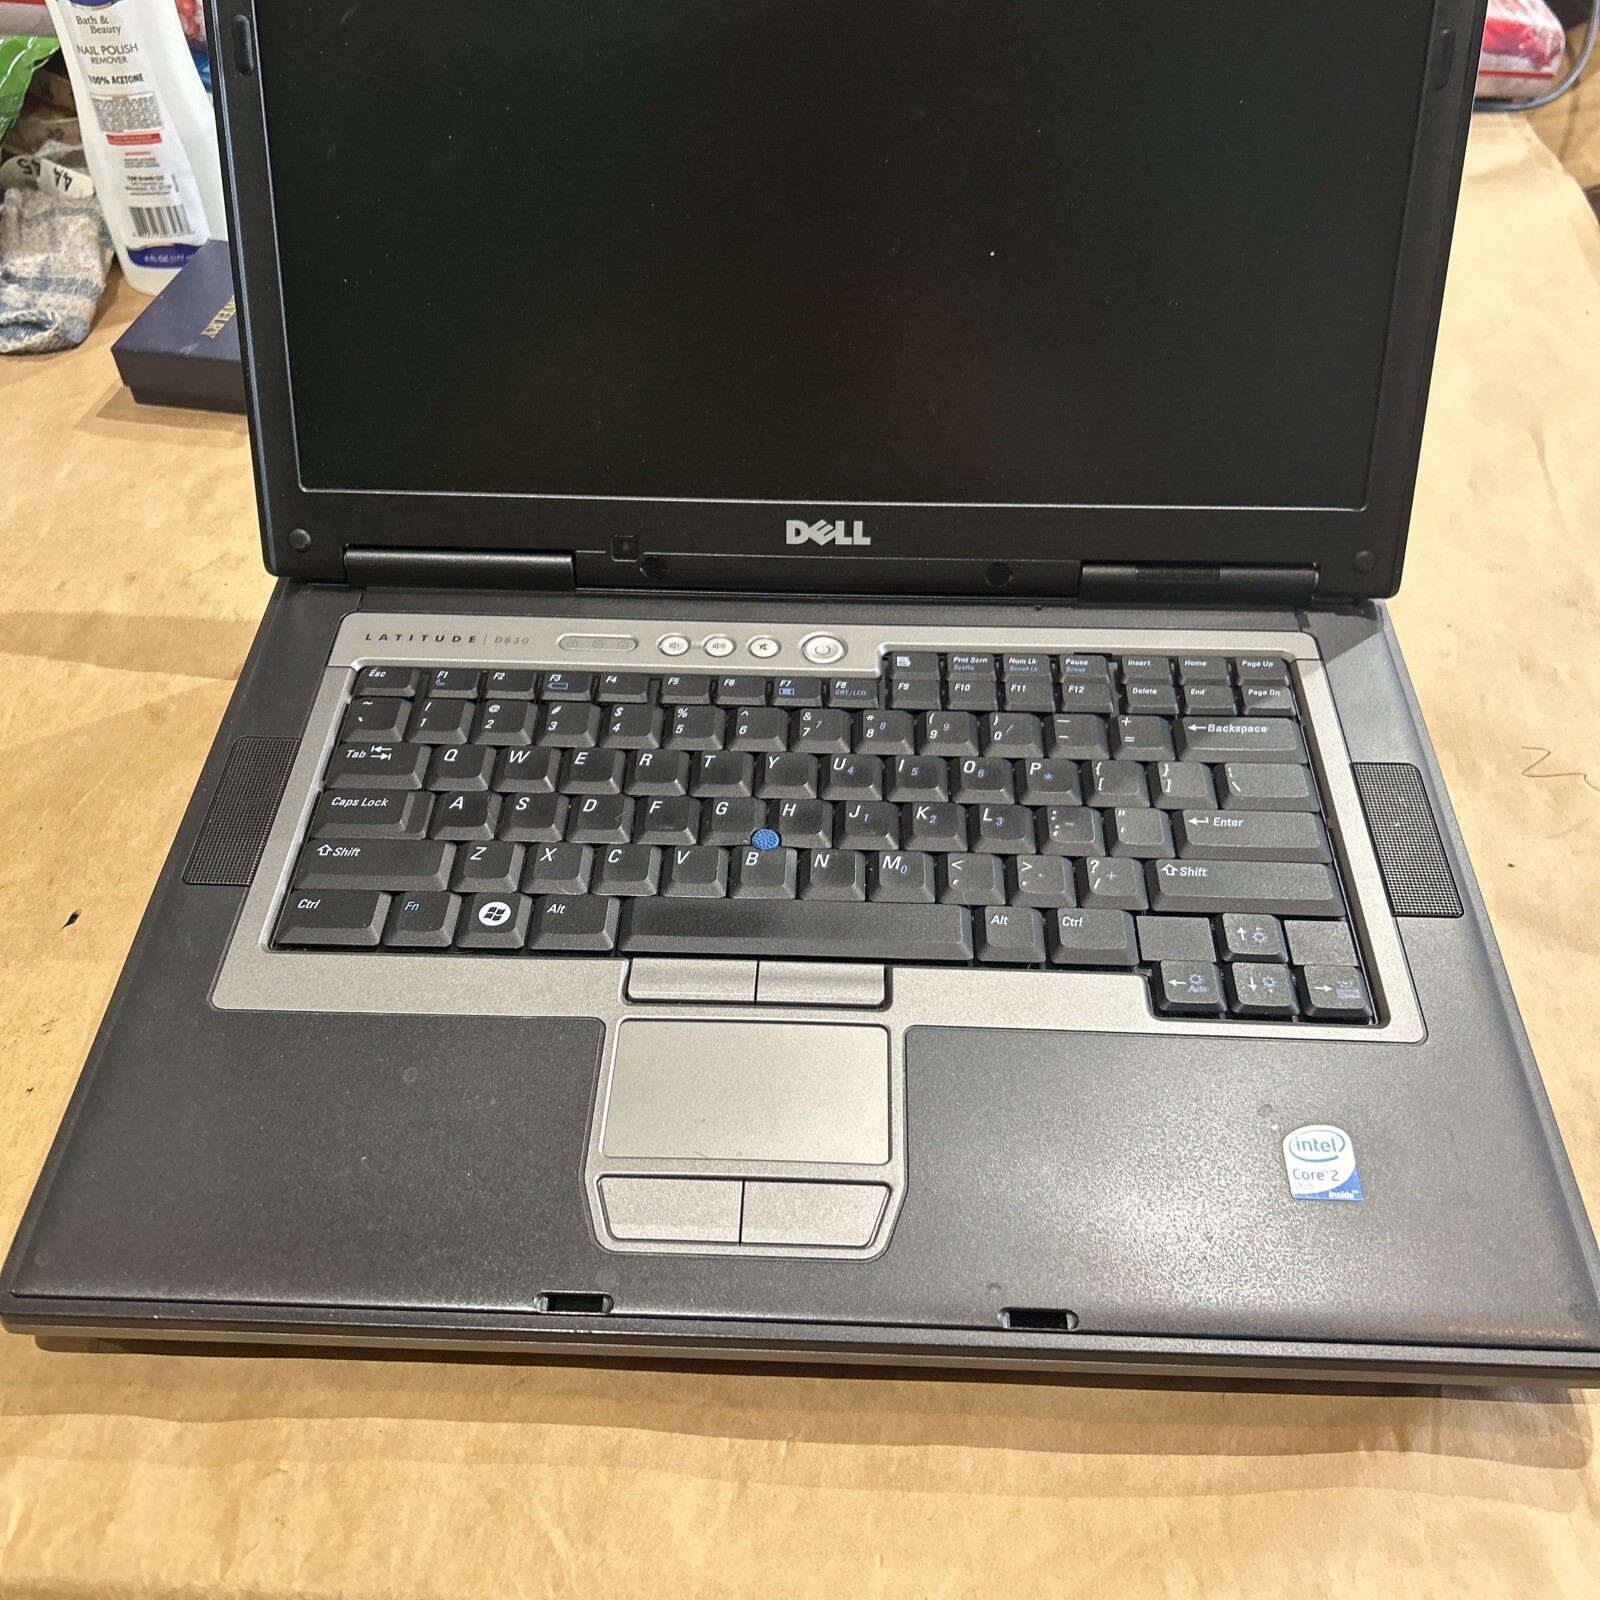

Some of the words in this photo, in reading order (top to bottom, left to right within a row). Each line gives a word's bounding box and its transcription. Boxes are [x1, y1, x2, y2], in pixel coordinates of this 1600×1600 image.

[76, 15, 98, 25] Bath
[100, 15, 109, 25] &
[90, 25, 122, 36] Beauty
[76, 44, 100, 56] NAIL
[101, 42, 139, 56] POLISH
[90, 55, 129, 65] REMOVER
[88, 75, 110, 85] 100%
[111, 73, 144, 85] ACETONE
[53, 166, 73, 192] 44
[785, 519, 871, 546] DELL
[365, 633, 477, 643] LATITUDE
[494, 636, 530, 645] D830
[970, 656, 988, 664] Scrn
[1008, 657, 1027, 665] Num
[1065, 658, 1089, 666] Pause
[1127, 659, 1151, 667] Insert
[1184, 659, 1207, 667] Home
[1241, 660, 1261, 668] Page
[1262, 660, 1274, 668] Up
[368, 669, 387, 678] Esc
[437, 670, 449, 679] F1
[493, 672, 506, 681] F2
[549, 674, 562, 683] F3
[605, 675, 618, 684] F4
[667, 677, 680, 685] F5
[723, 678, 736, 687] F6
[779, 679, 792, 688] F7
[835, 681, 847, 689] F8
[898, 682, 910, 691] F9
[954, 683, 971, 692] F10
[1010, 684, 1026, 692] F11
[1068, 685, 1085, 694] F12
[1132, 687, 1158, 695] Delete
[1190, 688, 1205, 696] End
[1248, 688, 1268, 697] Page
[488, 703, 501, 713] @
[614, 706, 624, 717] $
[677, 708, 688, 718] %
[419, 717, 427, 728] 1
[803, 712, 812, 722] &
[484, 719, 494, 729] 2
[548, 720, 558, 731] 3
[611, 723, 621, 733] 4
[675, 724, 684, 734] 5
[816, 719, 822, 729] 7
[879, 722, 886, 730] 8
[943, 723, 950, 732] 9
[1207, 723, 1267, 734] Backspace
[738, 725, 747, 735] 6
[803, 727, 811, 737] 7
[866, 728, 875, 738] 8
[929, 729, 938, 739] 9
[993, 731, 1002, 741] 0
[346, 749, 367, 759] Tab
[443, 748, 458, 763] Q
[509, 749, 530, 764] W
[574, 751, 589, 765] E
[638, 752, 653, 766] R
[704, 754, 716, 768] T
[767, 756, 780, 769] Y
[833, 757, 847, 771] U
[847, 765, 854, 775] 4
[911, 767, 918, 776] 5
[977, 768, 985, 777] 6
[1029, 762, 1042, 775] P
[331, 796, 359, 808] Caps
[360, 797, 389, 807] Lock
[449, 796, 464, 810] A
[515, 797, 530, 811] S
[582, 798, 598, 812] D
[649, 800, 662, 814] F
[715, 801, 729, 816] G
[782, 803, 797, 817] H
[849, 805, 861, 819] J
[916, 806, 931, 820] K
[928, 814, 937, 824] 2
[983, 808, 993, 822] L
[996, 816, 1003, 826] 3
[1213, 816, 1244, 828] Enter
[332, 845, 361, 858] Shift
[470, 847, 488, 861] Z
[540, 848, 558, 862] X
[607, 849, 622, 863] C
[677, 851, 691, 865] V
[745, 852, 759, 866] B
[814, 855, 829, 868] N
[882, 856, 901, 870] M
[1090, 859, 1100, 873] ?
[1179, 865, 1208, 878] Shift
[297, 898, 321, 910] Ctrl
[404, 900, 420, 912] Fn
[547, 903, 566, 915] Alt
[990, 914, 1009, 926] Alt
[1061, 916, 1083, 928] Ctrl
[1295, 1137, 1337, 1153] intel
[1292, 1168, 1325, 1181] Core
[1330, 1169, 1341, 1182] 2
